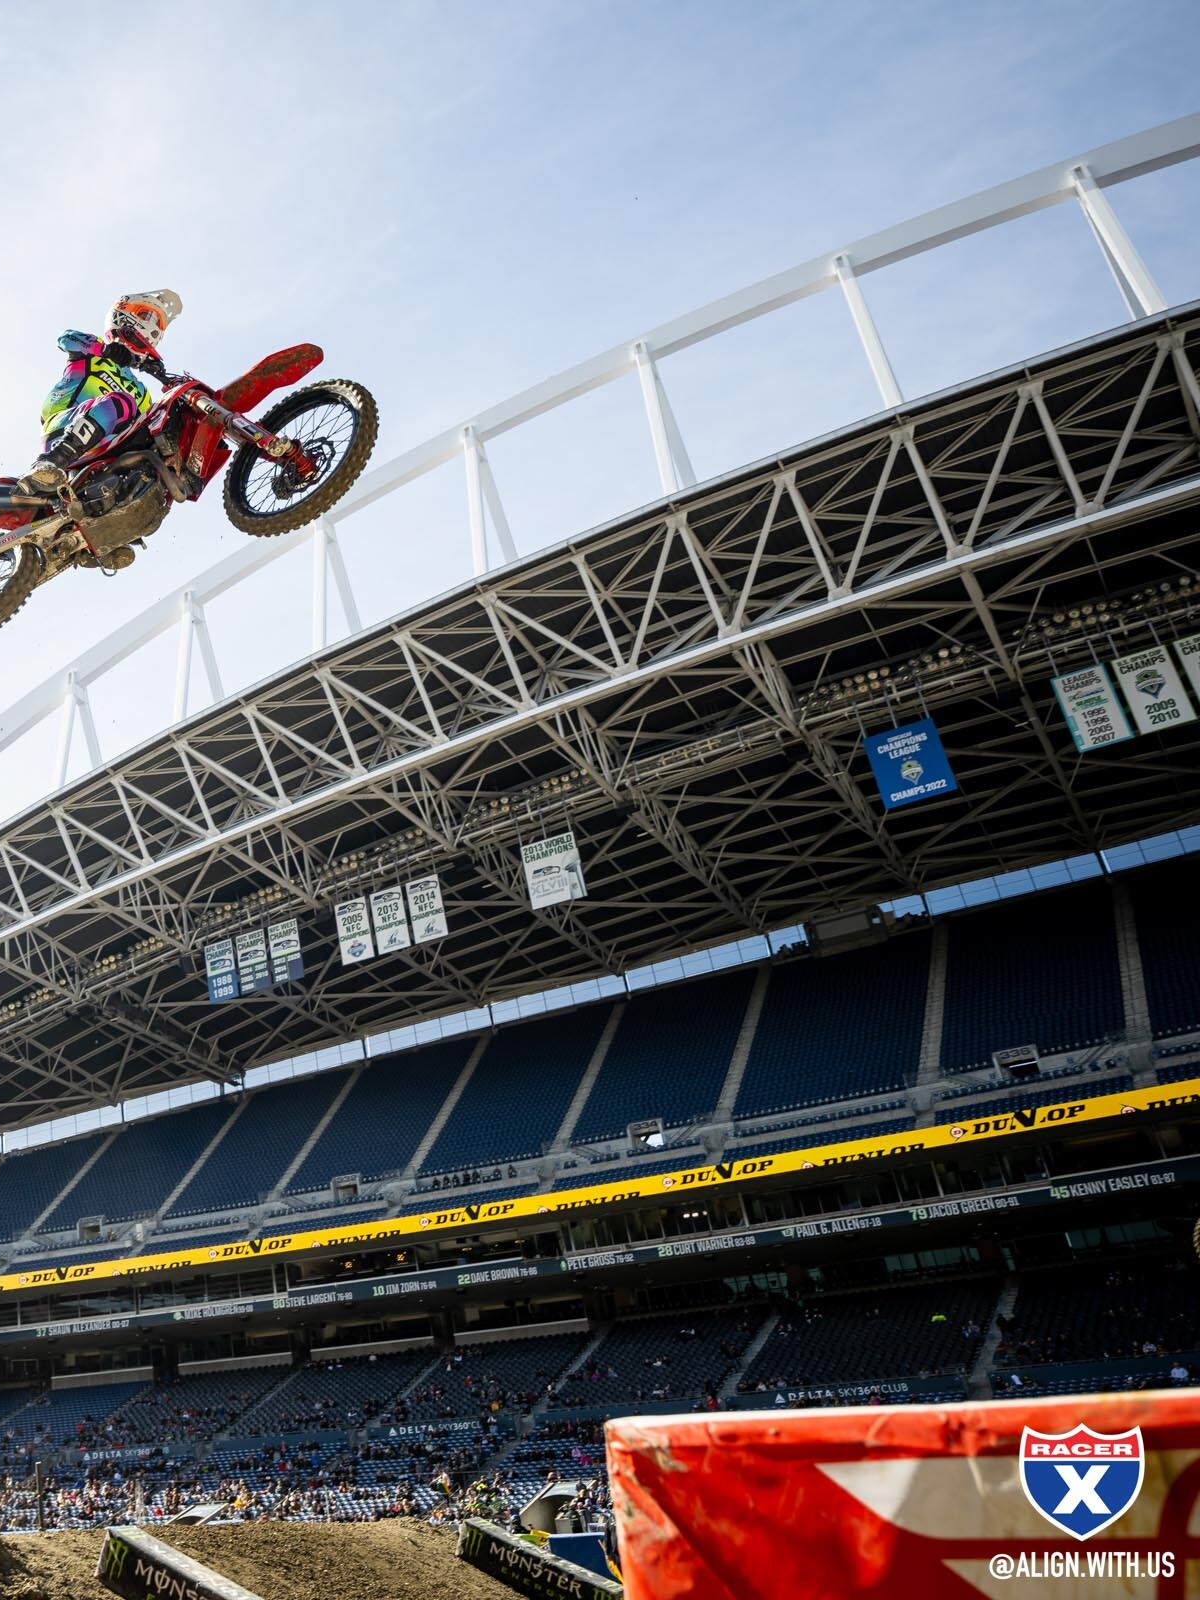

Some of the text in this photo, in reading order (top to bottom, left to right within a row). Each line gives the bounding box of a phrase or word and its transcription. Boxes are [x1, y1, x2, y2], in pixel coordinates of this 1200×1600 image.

[1119, 654, 1166, 674] CHAMPS
[1061, 670, 1097, 685] LEAGUE
[1063, 677, 1101, 693] CHAMPS
[1144, 698, 1176, 714] 2009
[1149, 708, 1180, 724] 2010
[1088, 724, 1113, 736] 2005
[877, 732, 928, 754] CHAMPIONS
[1091, 732, 1116, 744] 2007
[888, 743, 921, 759] LEAGUE
[890, 779, 947, 802] CHAMPS 2022
[523, 834, 572, 856] 2013 WORLD
[524, 843, 574, 864] CHAMPIONS
[413, 891, 436, 905] 2014
[377, 902, 399, 916] 2013
[412, 907, 443, 921] CHAMPIONS
[418, 901, 434, 913] NFC
[341, 913, 363, 926] 2005
[376, 919, 407, 932] CHAMPIONS
[382, 913, 397, 923] NFC
[270, 927, 297, 940] CHAMPS
[340, 929, 370, 942] CHAMPIONS
[346, 923, 361, 933] NFC
[238, 938, 264, 951] CHAMPS
[207, 947, 232, 960] CHAMPS
[213, 985, 234, 998] 1999
[1050, 1172, 1176, 1199] 45 KENNY EASLEY 81-87
[909, 1208, 928, 1221] 79
[928, 1202, 959, 1219] JACOB
[960, 1197, 995, 1214] GREEN
[797, 1217, 882, 1238] PAUL G. ALLEN 97-18
[658, 1245, 673, 1257] 28
[673, 1241, 696, 1255] CURT
[698, 1236, 735, 1252] WARNER
[568, 1257, 587, 1271] PETE
[588, 1254, 615, 1268] GROSS
[457, 1274, 471, 1285] 22
[471, 1270, 490, 1283] DAVE
[490, 1266, 520, 1281] BROWN
[372, 1286, 385, 1296] 10
[385, 1283, 400, 1296] JIM
[400, 1281, 420, 1293] ZORN
[273, 1299, 285, 1310] 80
[285, 1296, 306, 1309] STEVE
[306, 1291, 337, 1306] LARGENT
[184, 1308, 203, 1320] MIKE
[203, 1305, 238, 1319] HOLMGREN
[36, 1328, 46, 1337] 37
[48, 1325, 71, 1336] SHAUN
[72, 1320, 111, 1334] ALEXANDER
[399, 1425, 434, 1435] DELTA
[92, 1450, 122, 1460] DELTA
